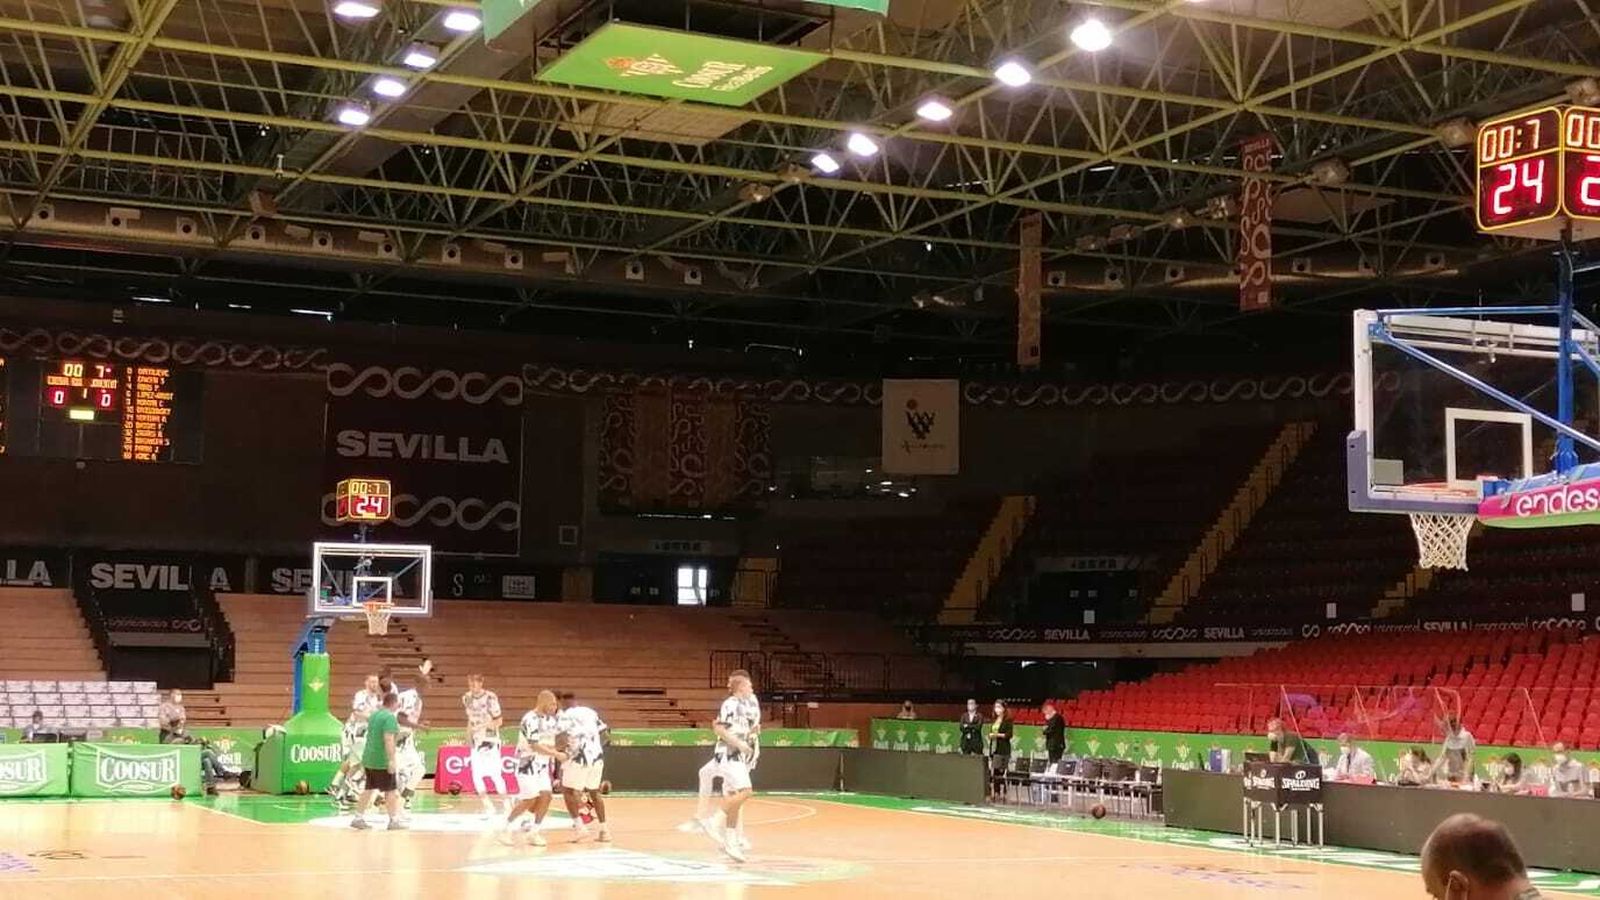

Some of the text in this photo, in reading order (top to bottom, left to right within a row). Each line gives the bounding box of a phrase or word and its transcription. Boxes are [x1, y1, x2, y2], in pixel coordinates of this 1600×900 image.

[1482, 119, 1540, 162] 00:7
[1494, 159, 1545, 215] 24
[54, 390, 65, 404] 0
[101, 393, 111, 407] 0
[336, 429, 510, 464] SEVILLA
[356, 495, 383, 514] 24
[1516, 484, 1600, 517] endes
[0, 559, 52, 587] LA
[1044, 628, 1091, 641] SEVILLA
[1203, 626, 1245, 639] SEVILLA
[290, 743, 342, 764] COOSUR
[100, 755, 176, 784] COOSUR
